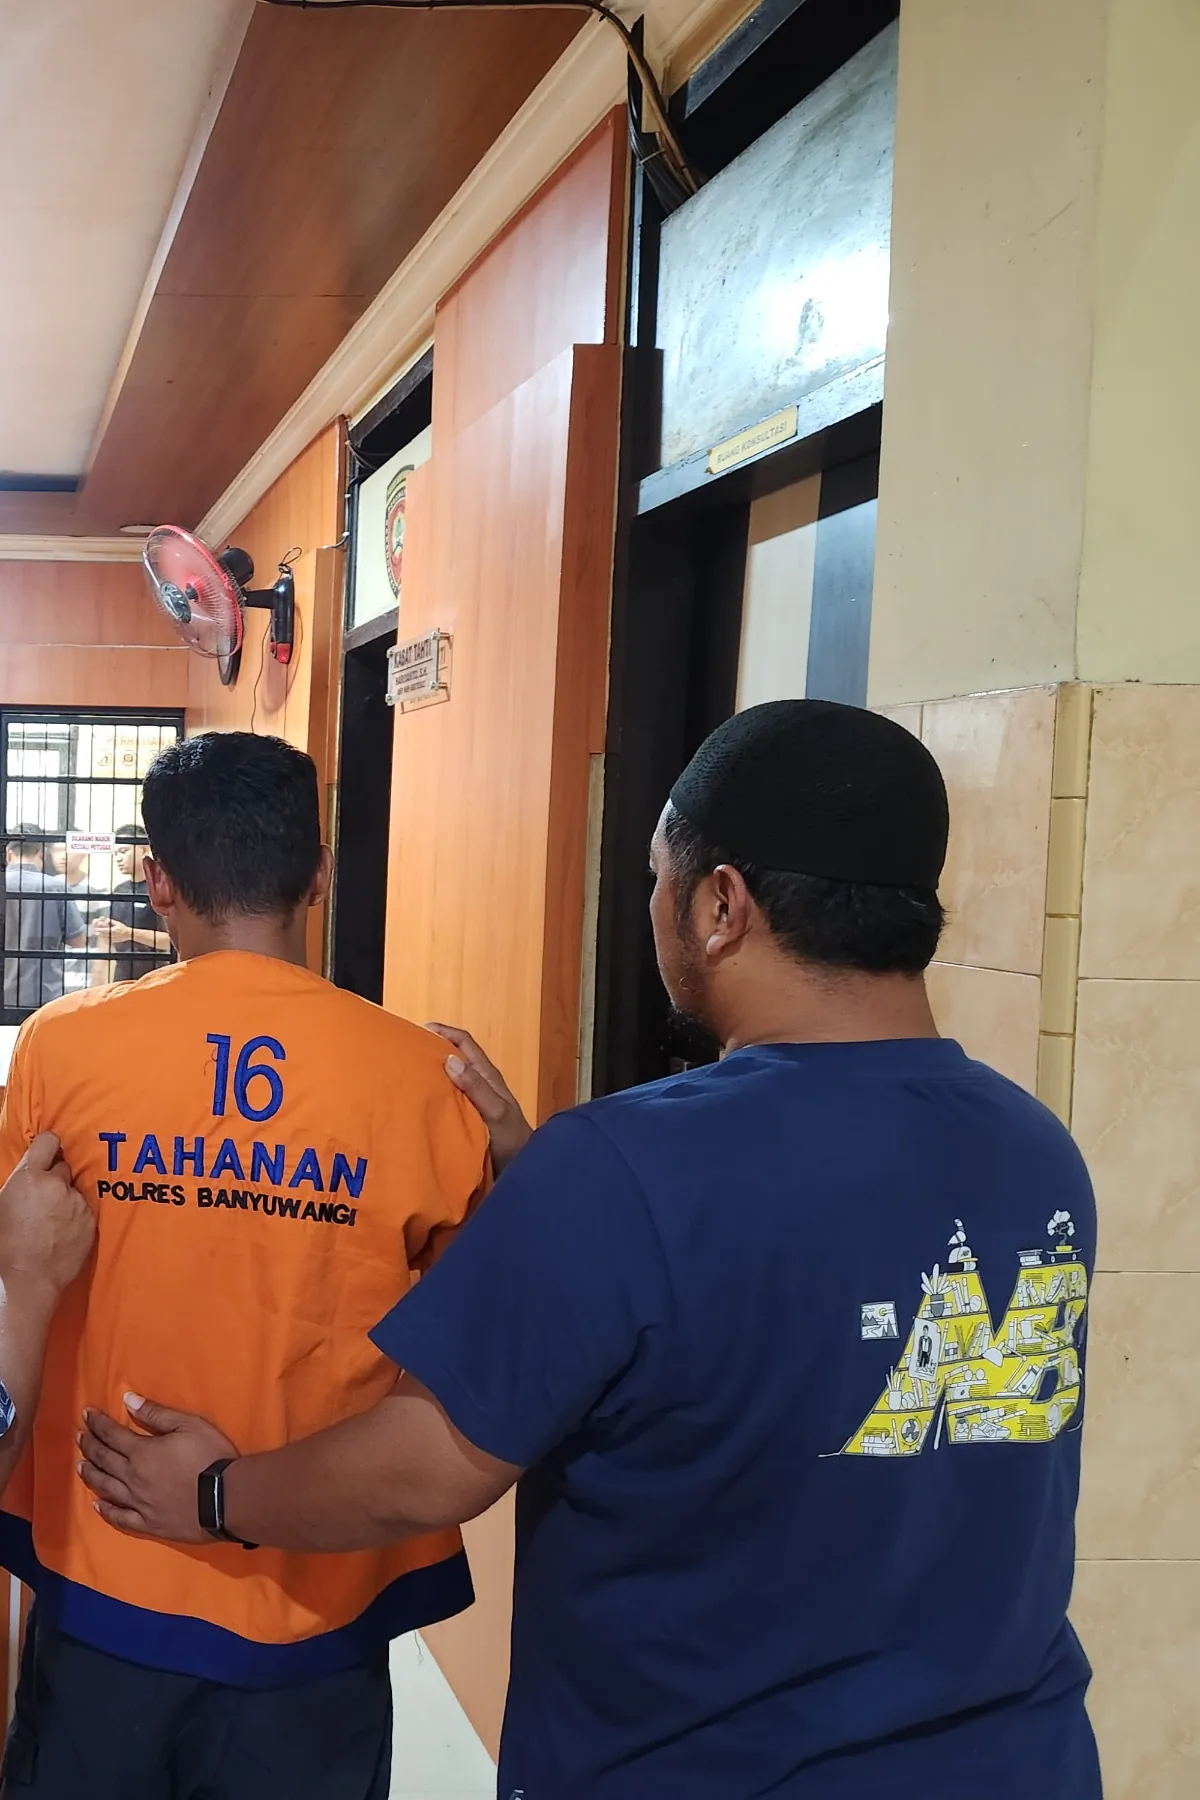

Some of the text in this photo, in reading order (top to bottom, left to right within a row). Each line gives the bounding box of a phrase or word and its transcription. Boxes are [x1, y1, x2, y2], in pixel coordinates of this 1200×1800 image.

[206, 1032, 287, 1123] 16
[98, 1131, 369, 1200] TAHANAN
[97, 1179, 357, 1227] POLRES BANYUWANGI
